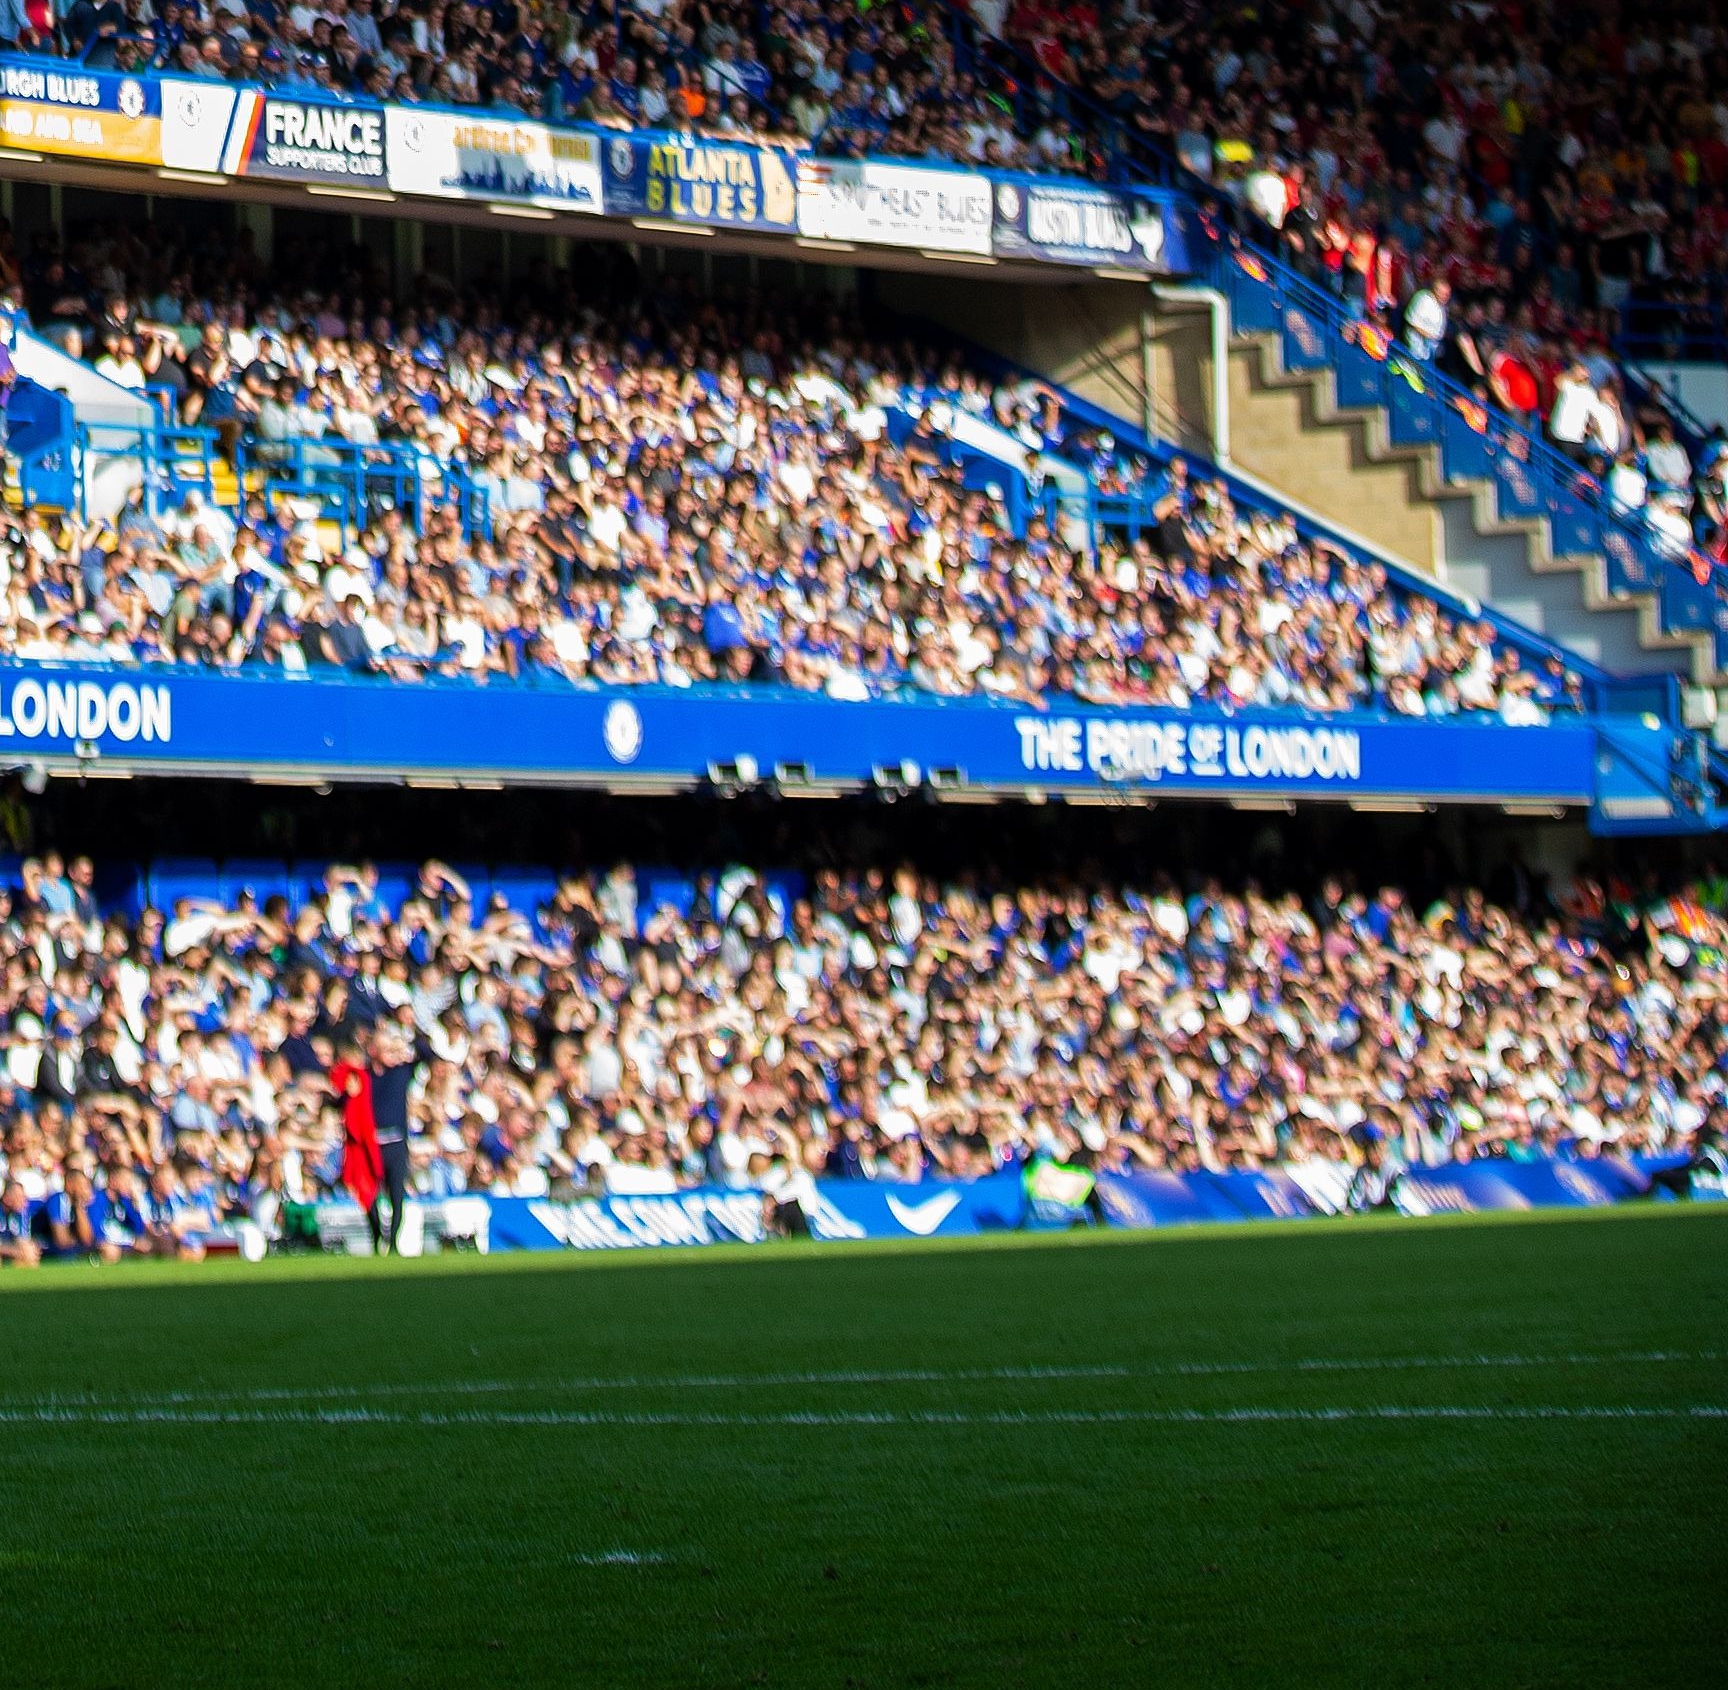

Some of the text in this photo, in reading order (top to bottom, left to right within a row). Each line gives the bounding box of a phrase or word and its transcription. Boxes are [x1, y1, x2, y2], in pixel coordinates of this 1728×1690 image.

[47, 73, 100, 107] BLUES
[266, 102, 383, 156] FRANCE
[266, 144, 348, 174] SUPPORTERS
[648, 144, 756, 187] ATLANTA
[646, 178, 757, 223] BLUES
[1014, 717, 1084, 771] THE
[1087, 719, 1188, 776] PRIDE
[1226, 725, 1361, 780] LONDON
